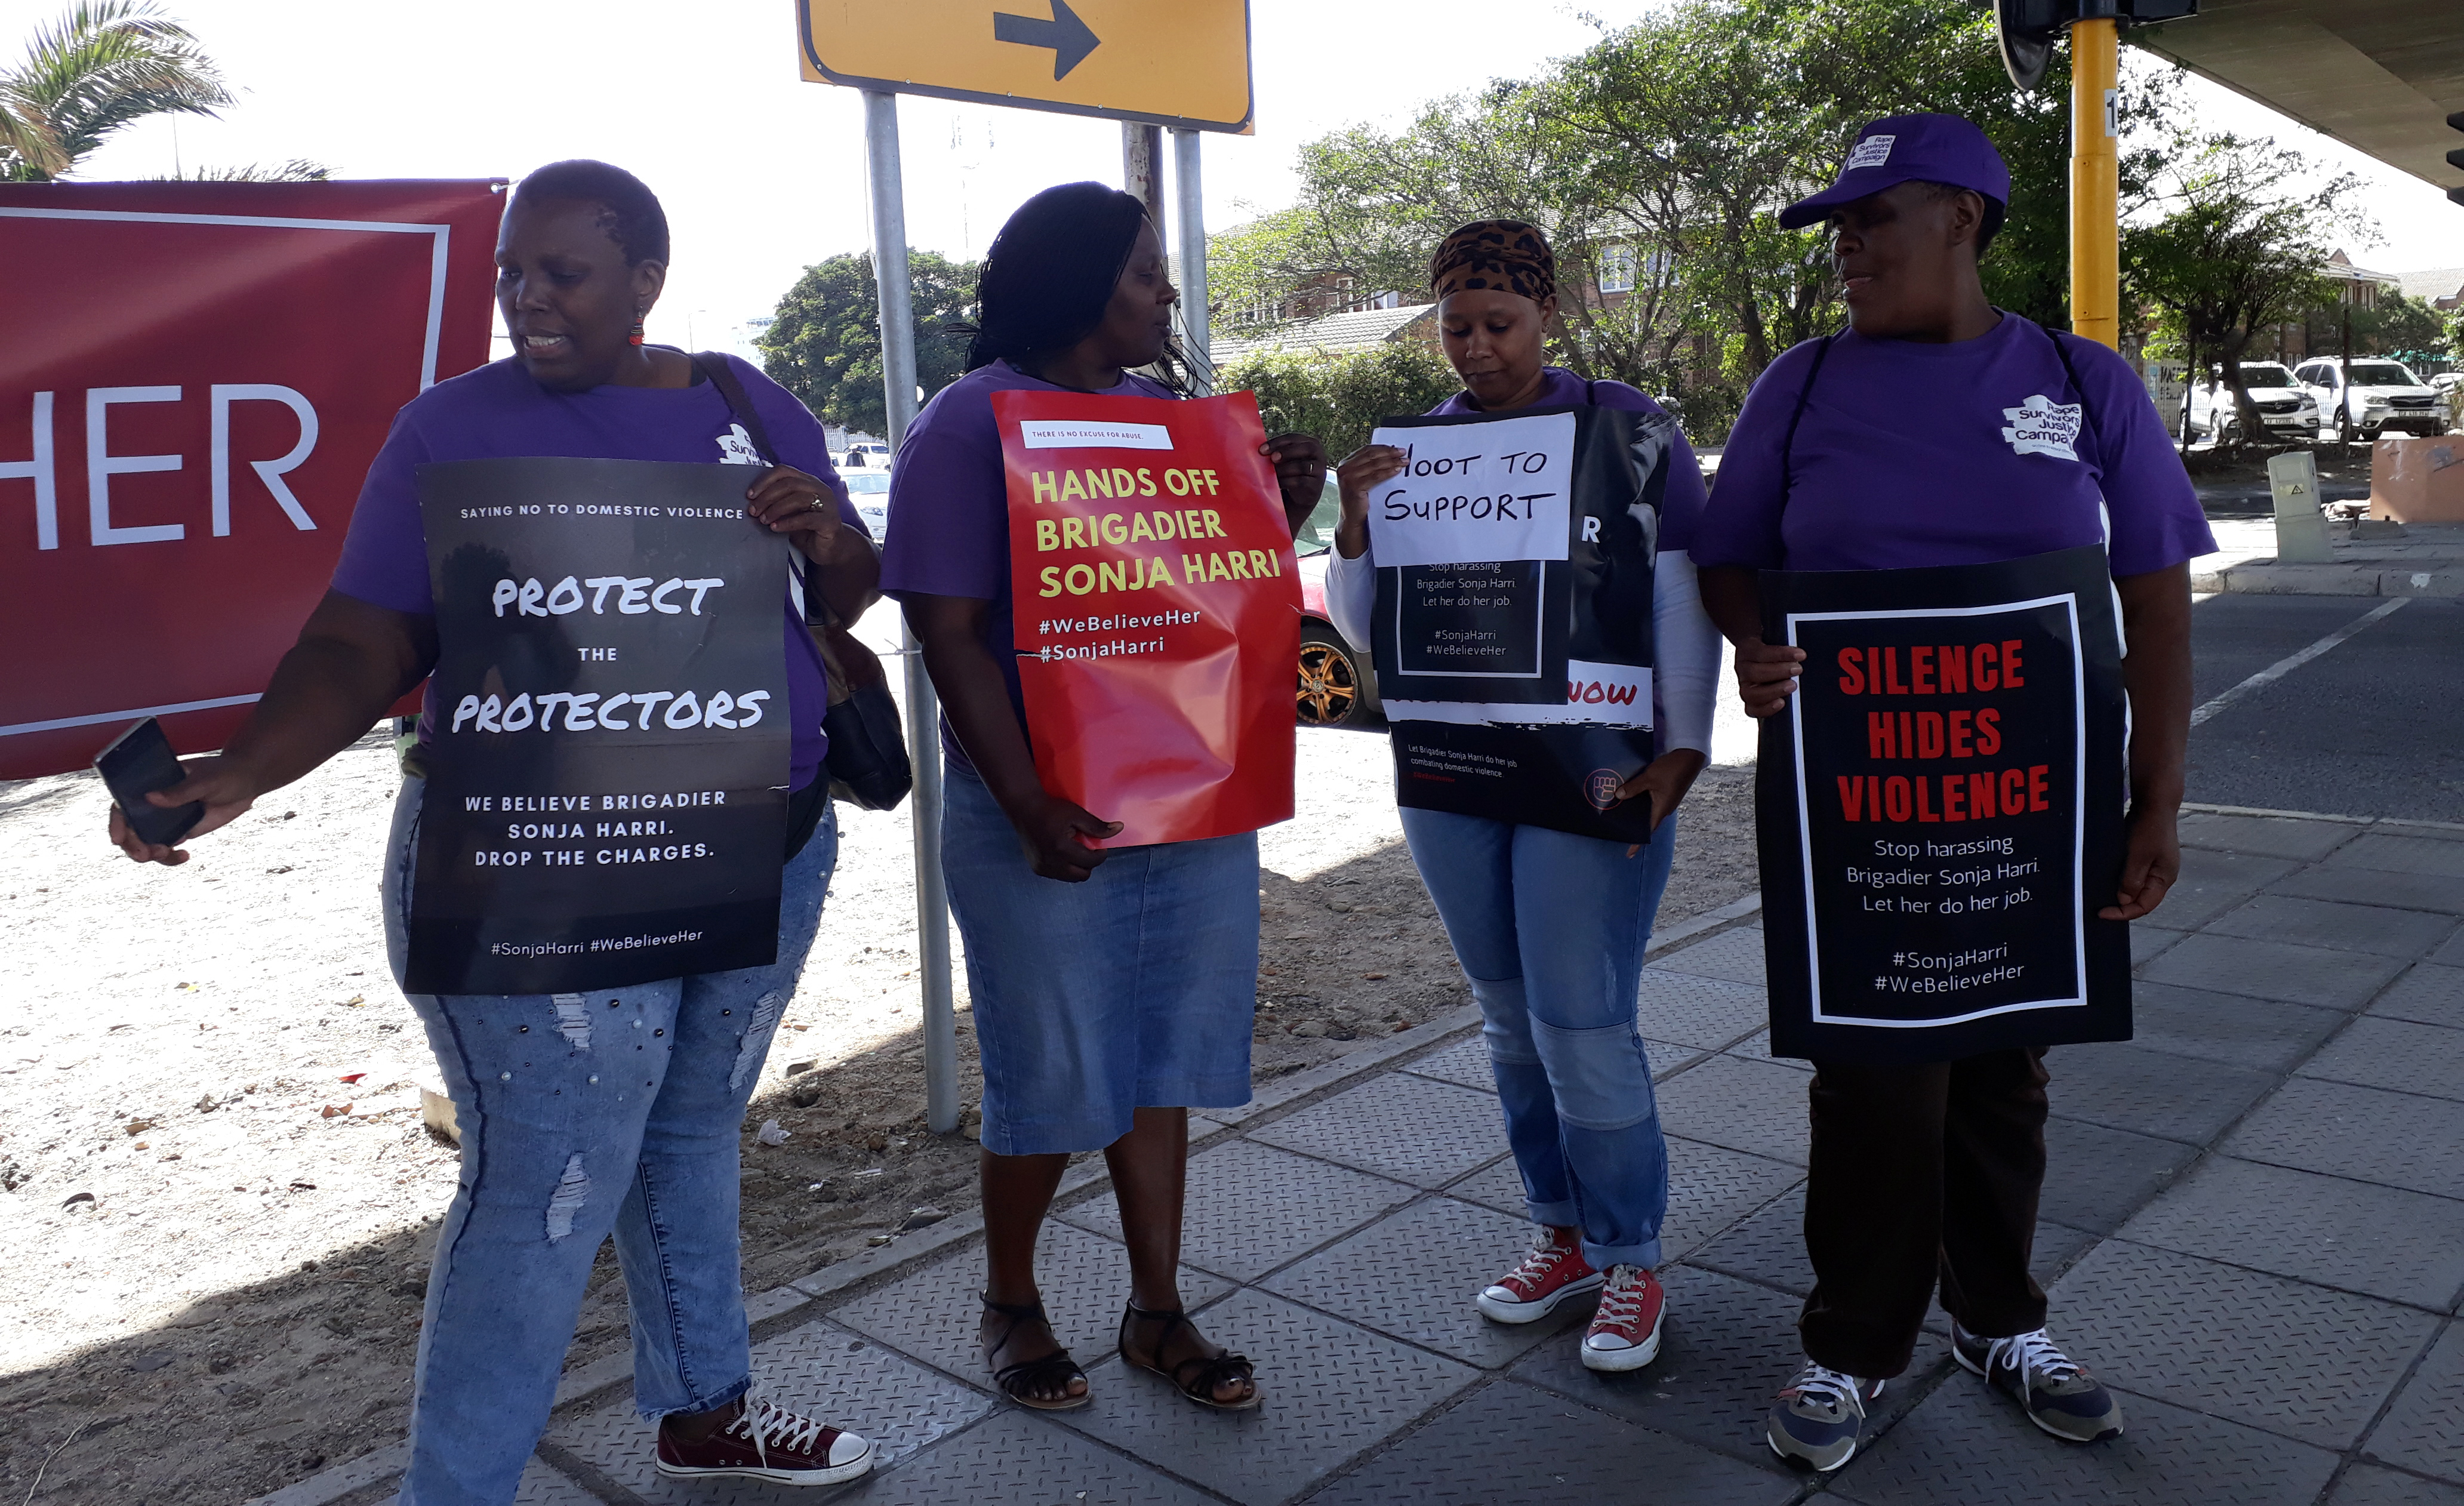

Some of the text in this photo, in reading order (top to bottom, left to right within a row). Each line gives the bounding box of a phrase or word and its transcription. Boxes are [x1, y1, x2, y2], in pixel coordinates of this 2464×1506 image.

[2047, 401, 2080, 415] Rape
[1500, 451, 1547, 475] TO
[1031, 468, 1220, 504] HANDS OFF
[461, 504, 743, 519] SAYING NO TO DOMESTIC VIOLENCE
[1036, 509, 1228, 552] BRIGADIER
[1039, 549, 1281, 598] SONJA HARRI
[1417, 577, 1517, 592] Brigadier Sonja Harri.
[492, 575, 725, 617] PROTECT
[1423, 595, 1512, 608] Let her do her job.
[1039, 609, 1201, 635] #WeBelieveHer
[1434, 629, 1496, 643] #SonjaHarri
[578, 648, 617, 661] THE
[1040, 637, 1164, 663] #SonjaHarri
[1426, 645, 1507, 655] #WeBelieveHer
[1838, 639, 2025, 695] SILENCE
[452, 689, 771, 734] PROTECTORS
[1868, 707, 2001, 759] HIDES
[1408, 744, 1517, 768] Let Brigadier Sonja Harri do her job
[1410, 758, 1443, 771] combating
[1444, 762, 1474, 774] domestic
[466, 791, 725, 811] WE BELIEVE BRIGADIER
[1837, 764, 2049, 823] VIOLENCE
[508, 820, 673, 839] SONJA HARRI.
[475, 843, 714, 866] DROP THE CHARGES.
[1874, 836, 2014, 861] Stop harassing
[1847, 857, 2040, 889] Brigadier Sonja Harri.
[1863, 886, 2033, 914] Let her do her job.
[491, 929, 703, 959] #SonjaHarri #WeBelieveHer
[1892, 942, 2009, 974] #SonjaHarri
[1874, 962, 2025, 993] #WeBelieveHer
